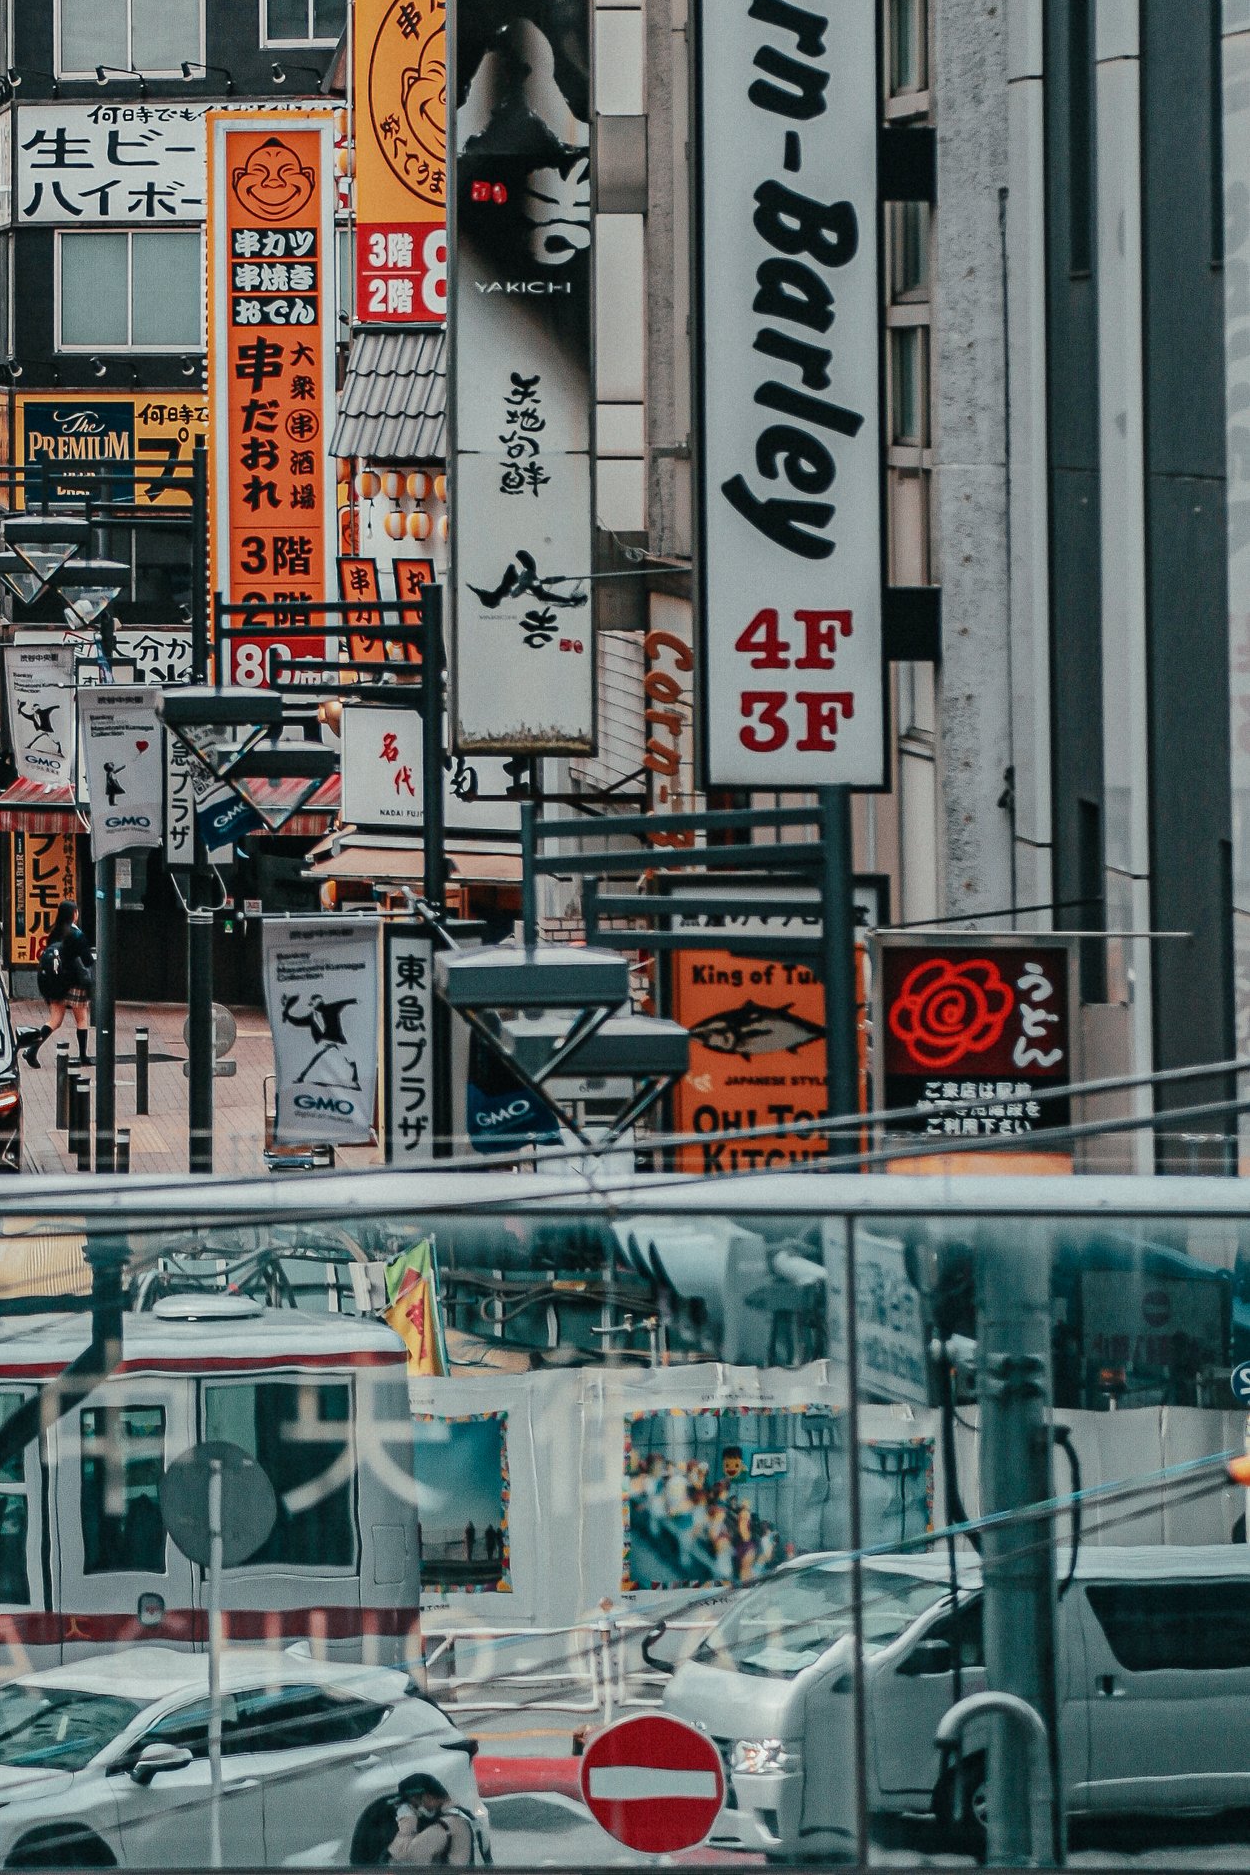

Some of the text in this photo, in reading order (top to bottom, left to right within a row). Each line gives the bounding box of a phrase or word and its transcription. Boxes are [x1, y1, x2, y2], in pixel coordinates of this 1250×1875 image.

[235, 229, 315, 258] 串カツ
[368, 232, 414, 269] 3階
[235, 263, 315, 292] 串焼き
[475, 281, 571, 294] YAKICHI
[235, 297, 316, 325] おでん
[368, 278, 414, 315] 2階
[53, 410, 106, 434] The
[235, 334, 285, 512] 串だおれ
[28, 431, 130, 462] PREMIUM
[240, 535, 314, 576] 3階
[734, 607, 854, 670] 4F
[739, 690, 855, 753] 3F
[25, 755, 61, 770] GMO
[105, 816, 151, 829] GMO
[379, 809, 405, 817] NADAI
[692, 963, 743, 987] King
[750, 964, 775, 985] of
[395, 953, 429, 1151] 東急プラザ
[294, 1094, 354, 1115] GMO
[475, 1099, 531, 1126] GMO
